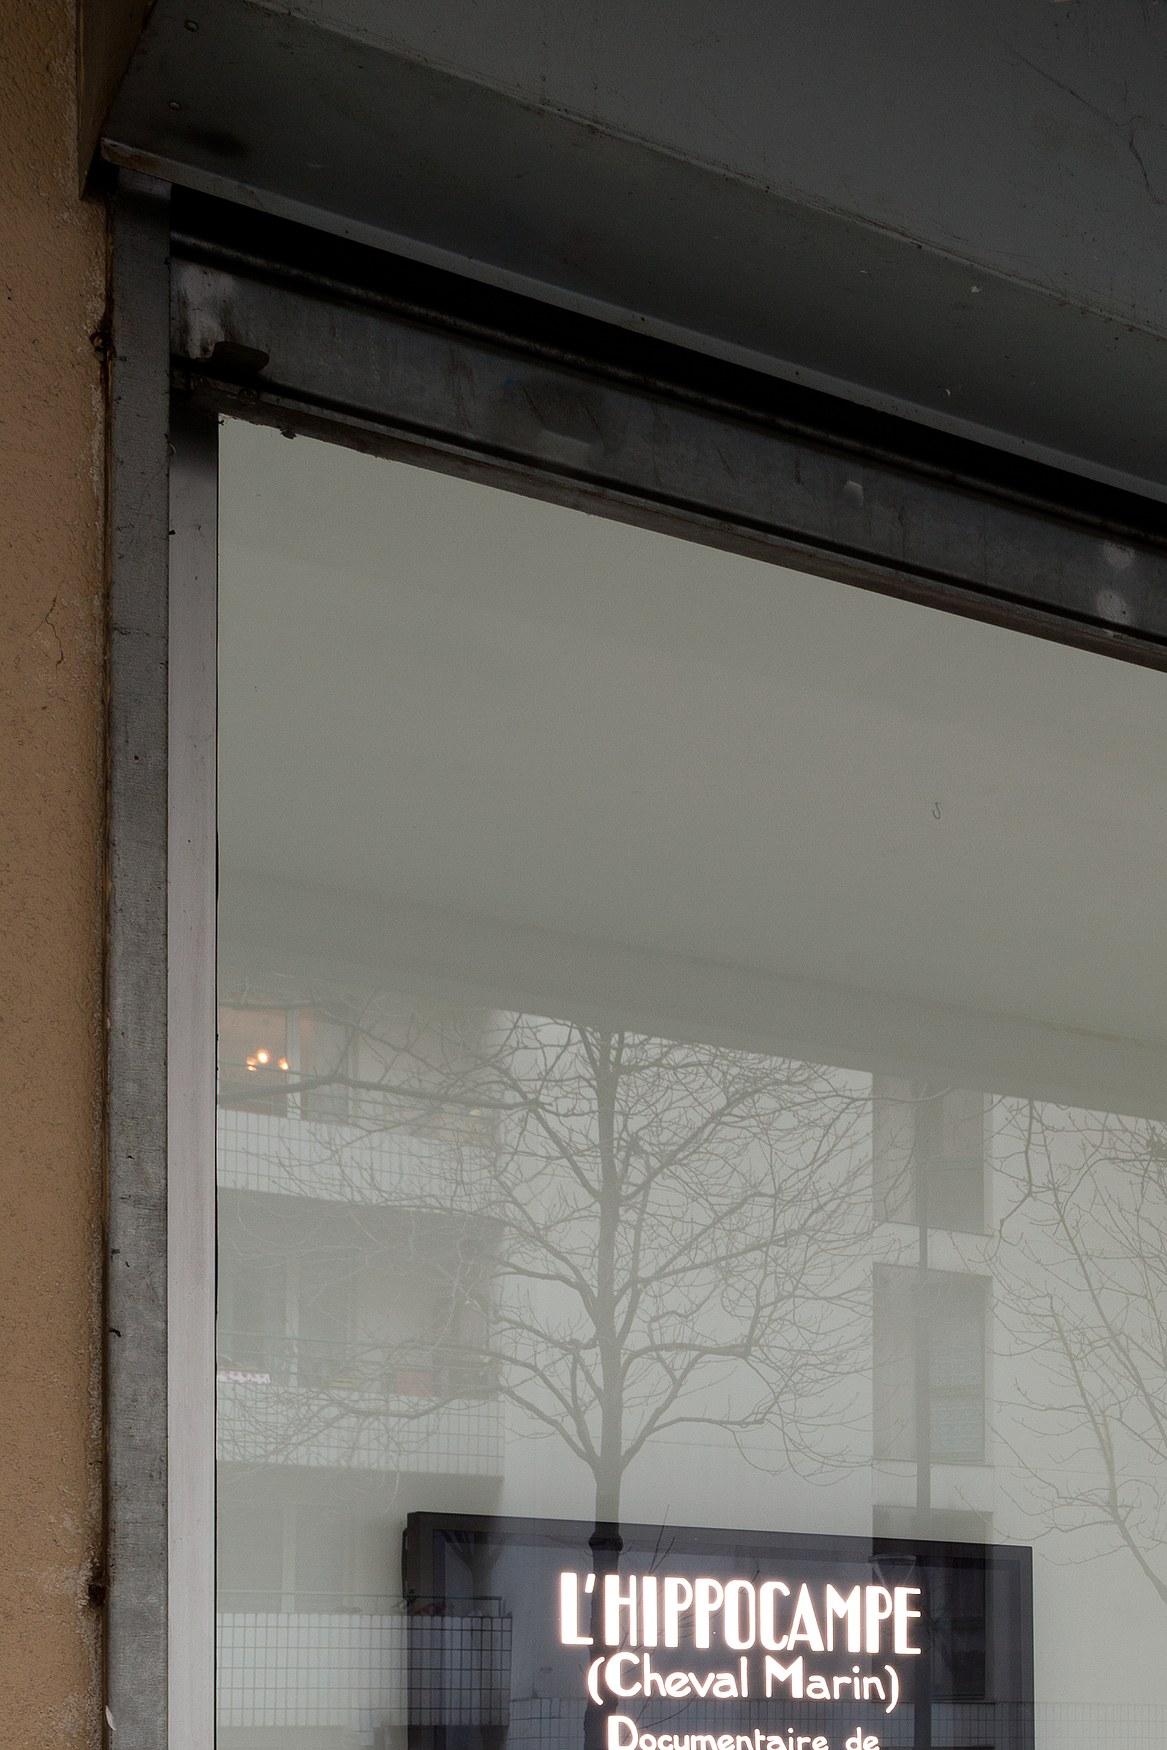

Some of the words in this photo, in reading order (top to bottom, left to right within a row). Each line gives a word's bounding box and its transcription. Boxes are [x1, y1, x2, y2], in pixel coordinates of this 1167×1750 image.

[558, 1571, 922, 1655] L'HIPPOCAMPE
[586, 1651, 749, 1706] (Cheval
[763, 1655, 900, 1714] Marin)
